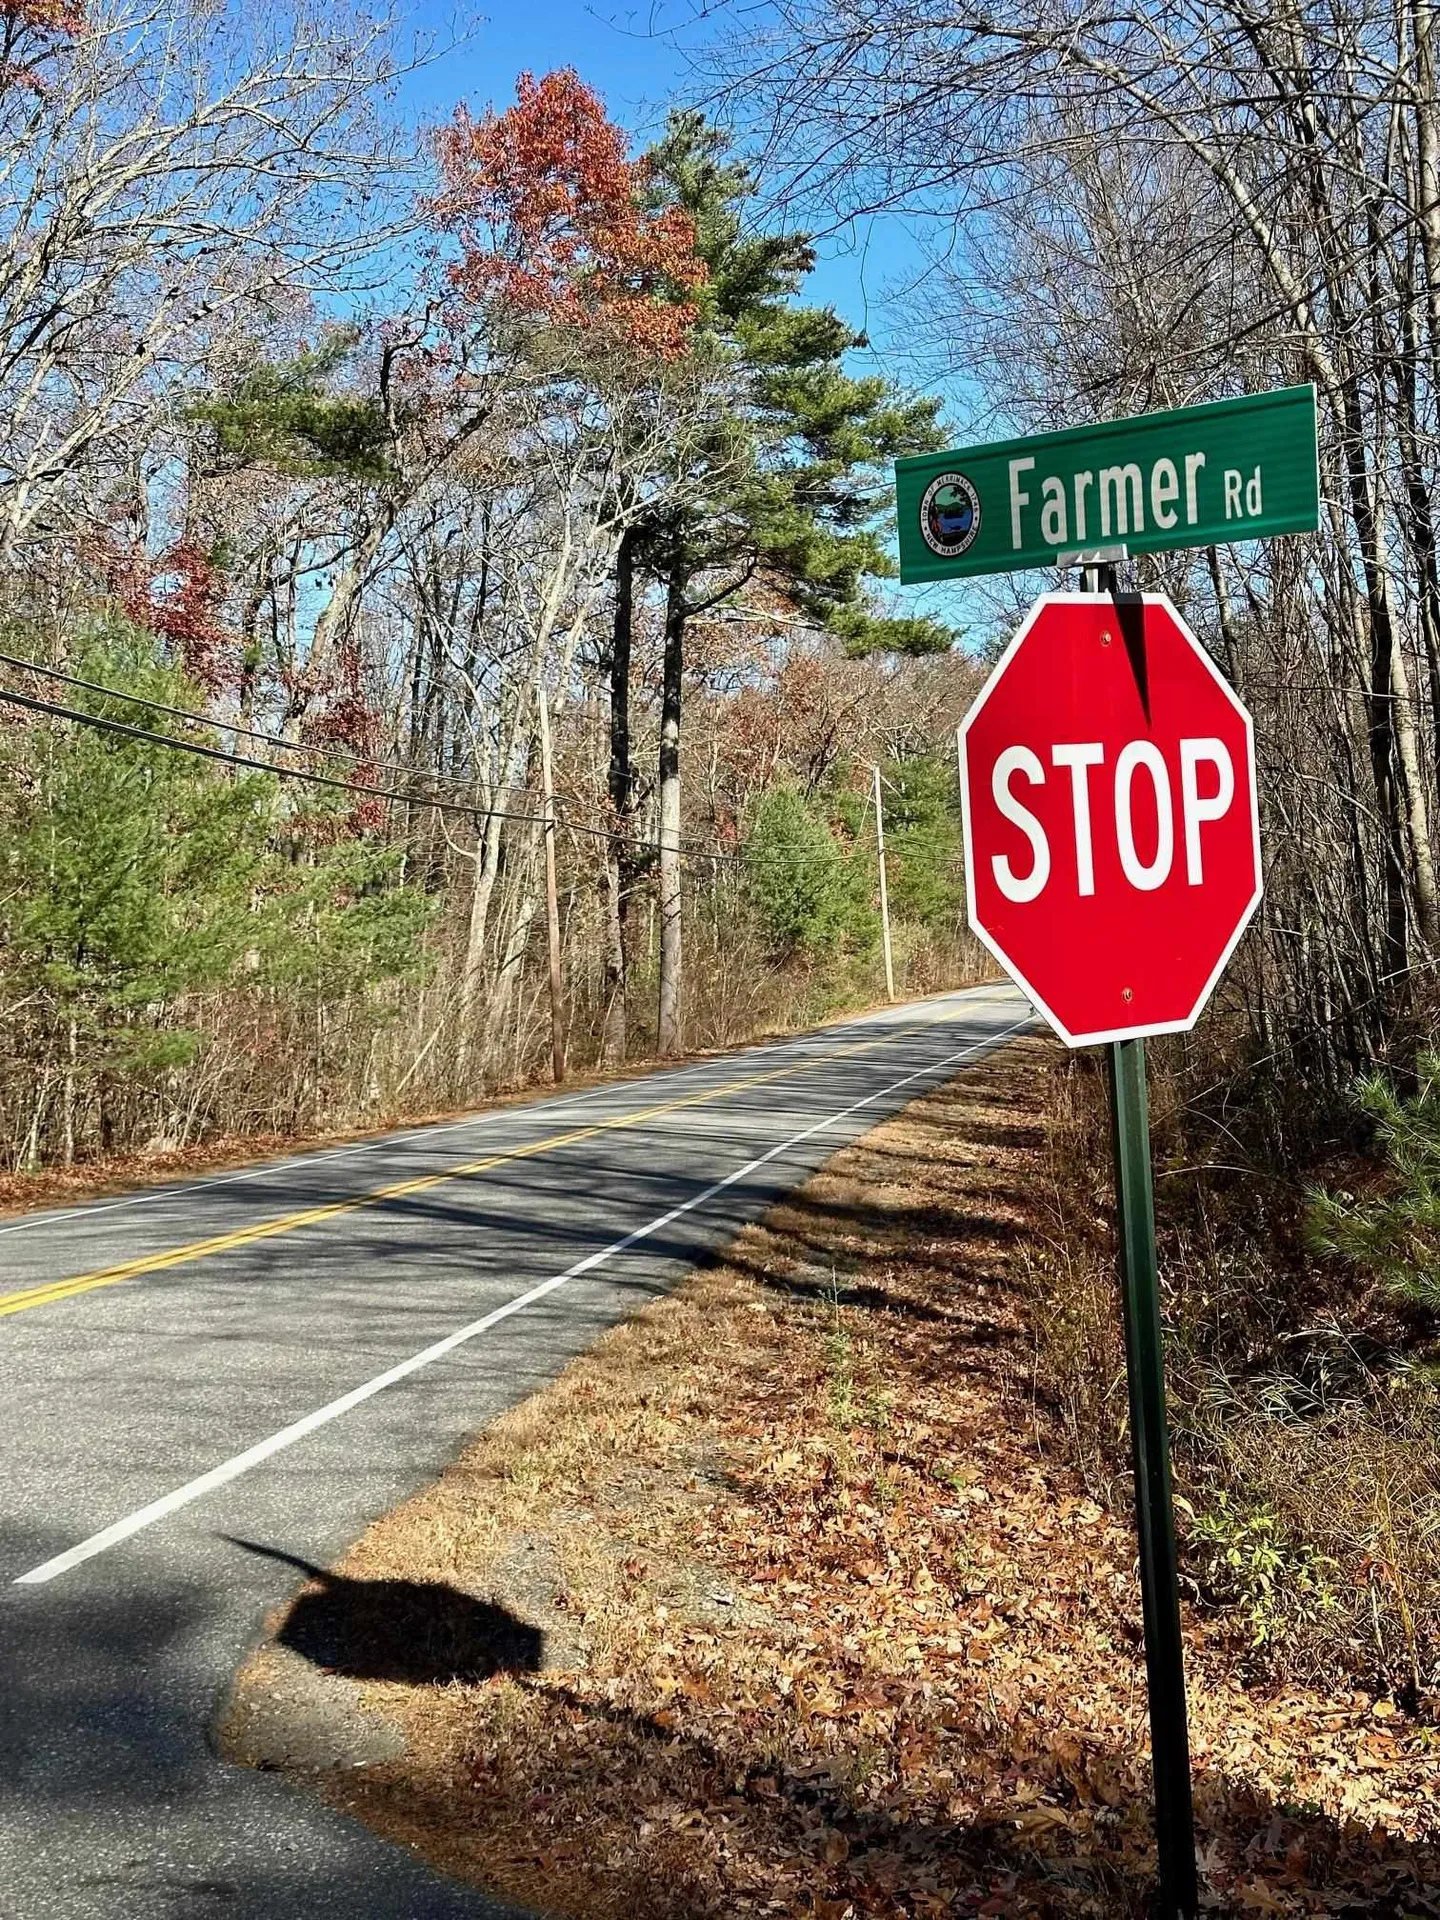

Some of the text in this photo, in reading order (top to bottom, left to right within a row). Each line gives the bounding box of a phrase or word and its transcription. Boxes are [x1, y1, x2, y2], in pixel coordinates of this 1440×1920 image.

[921, 500, 929, 522] TOWN
[928, 486, 935, 496] OF
[1008, 451, 1263, 550] Farmer Rd
[926, 533, 939, 549] NEW
[990, 737, 1235, 903] STOP
